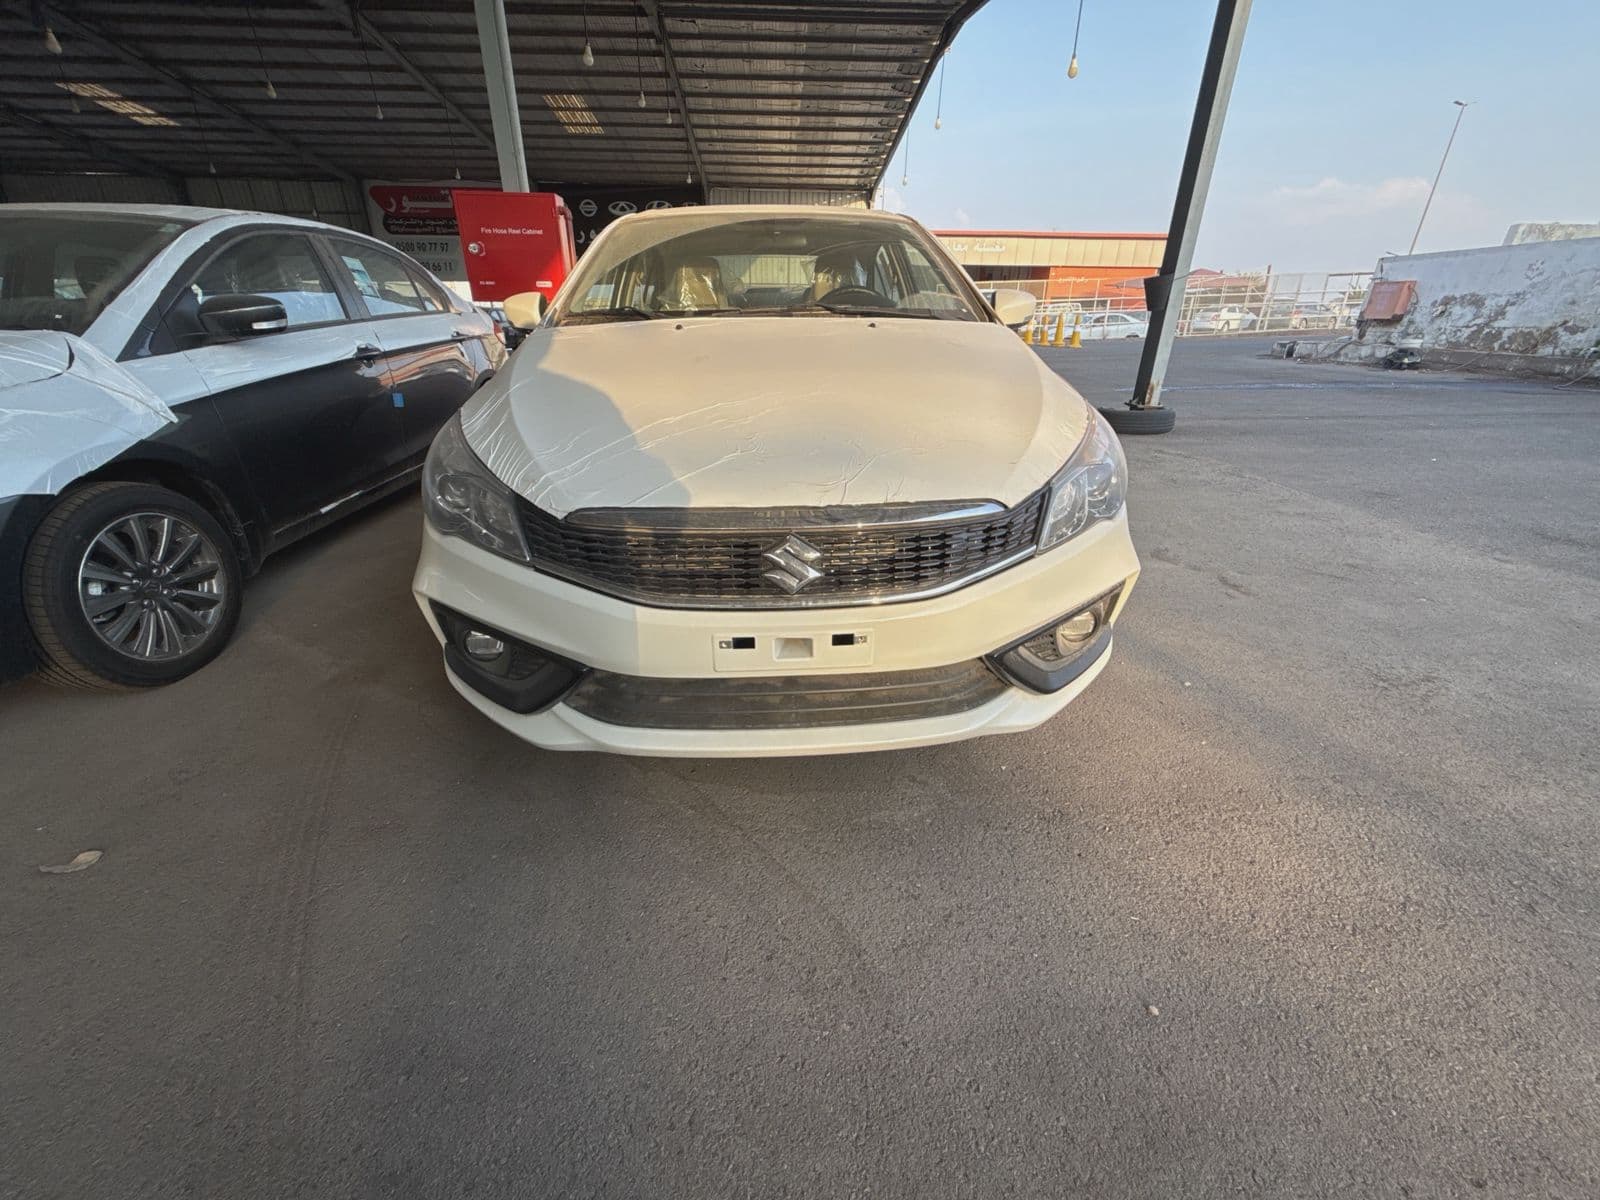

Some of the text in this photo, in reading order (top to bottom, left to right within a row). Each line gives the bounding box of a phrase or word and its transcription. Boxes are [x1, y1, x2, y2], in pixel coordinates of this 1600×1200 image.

[480, 226, 492, 234] Fire
[521, 227, 543, 235] Cabinet
[428, 242, 438, 252] 77
[439, 242, 449, 253] 97
[431, 262, 442, 272] 66
